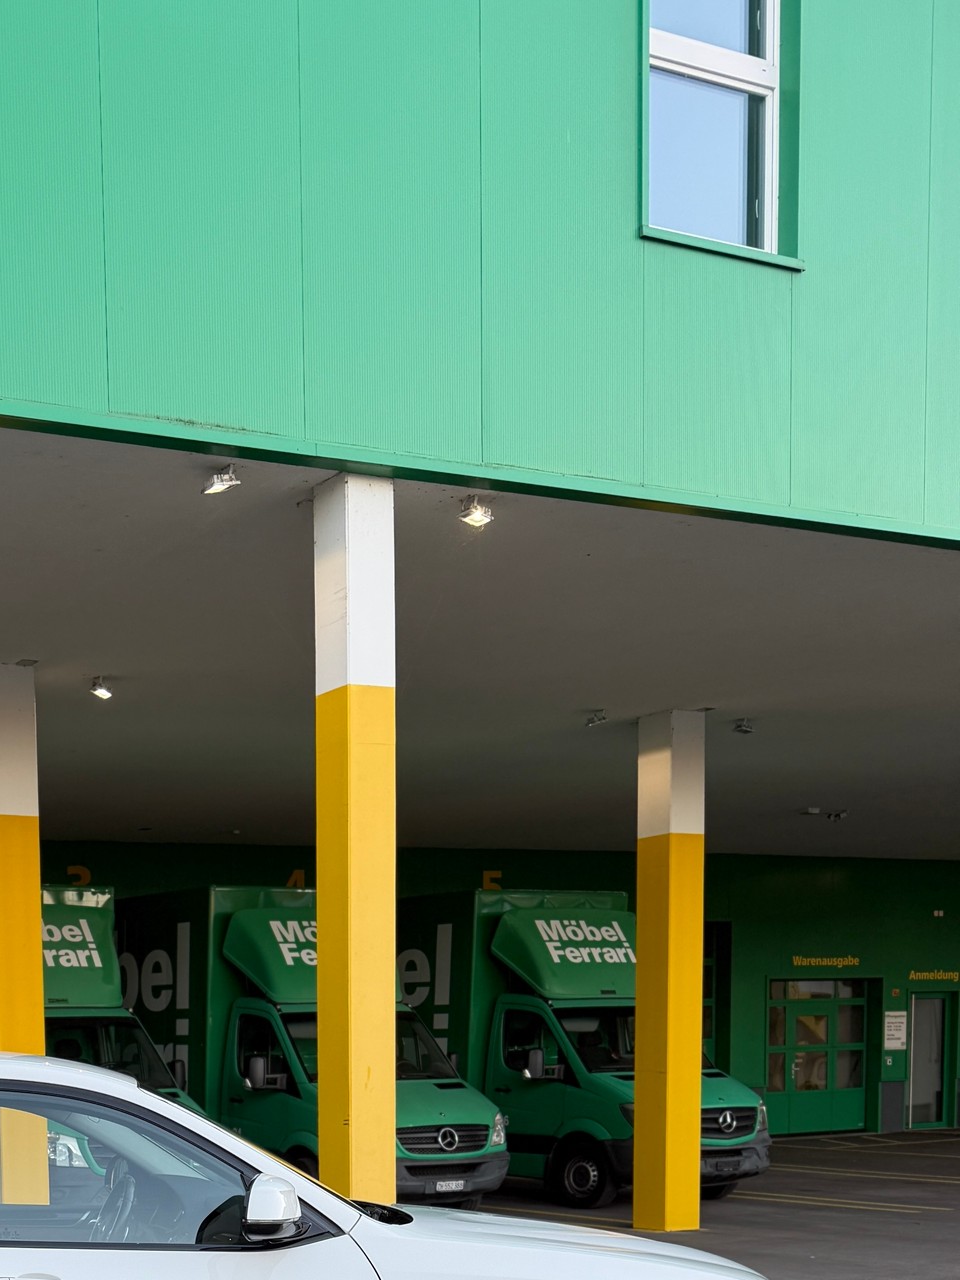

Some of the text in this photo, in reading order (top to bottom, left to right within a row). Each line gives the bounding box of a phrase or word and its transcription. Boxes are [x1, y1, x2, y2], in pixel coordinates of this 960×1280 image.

[534, 919, 627, 942] Möbel
[545, 942, 637, 964] Ferrari
[792, 955, 860, 968] Warenausgabe
[909, 969, 959, 981] Anmeldung
